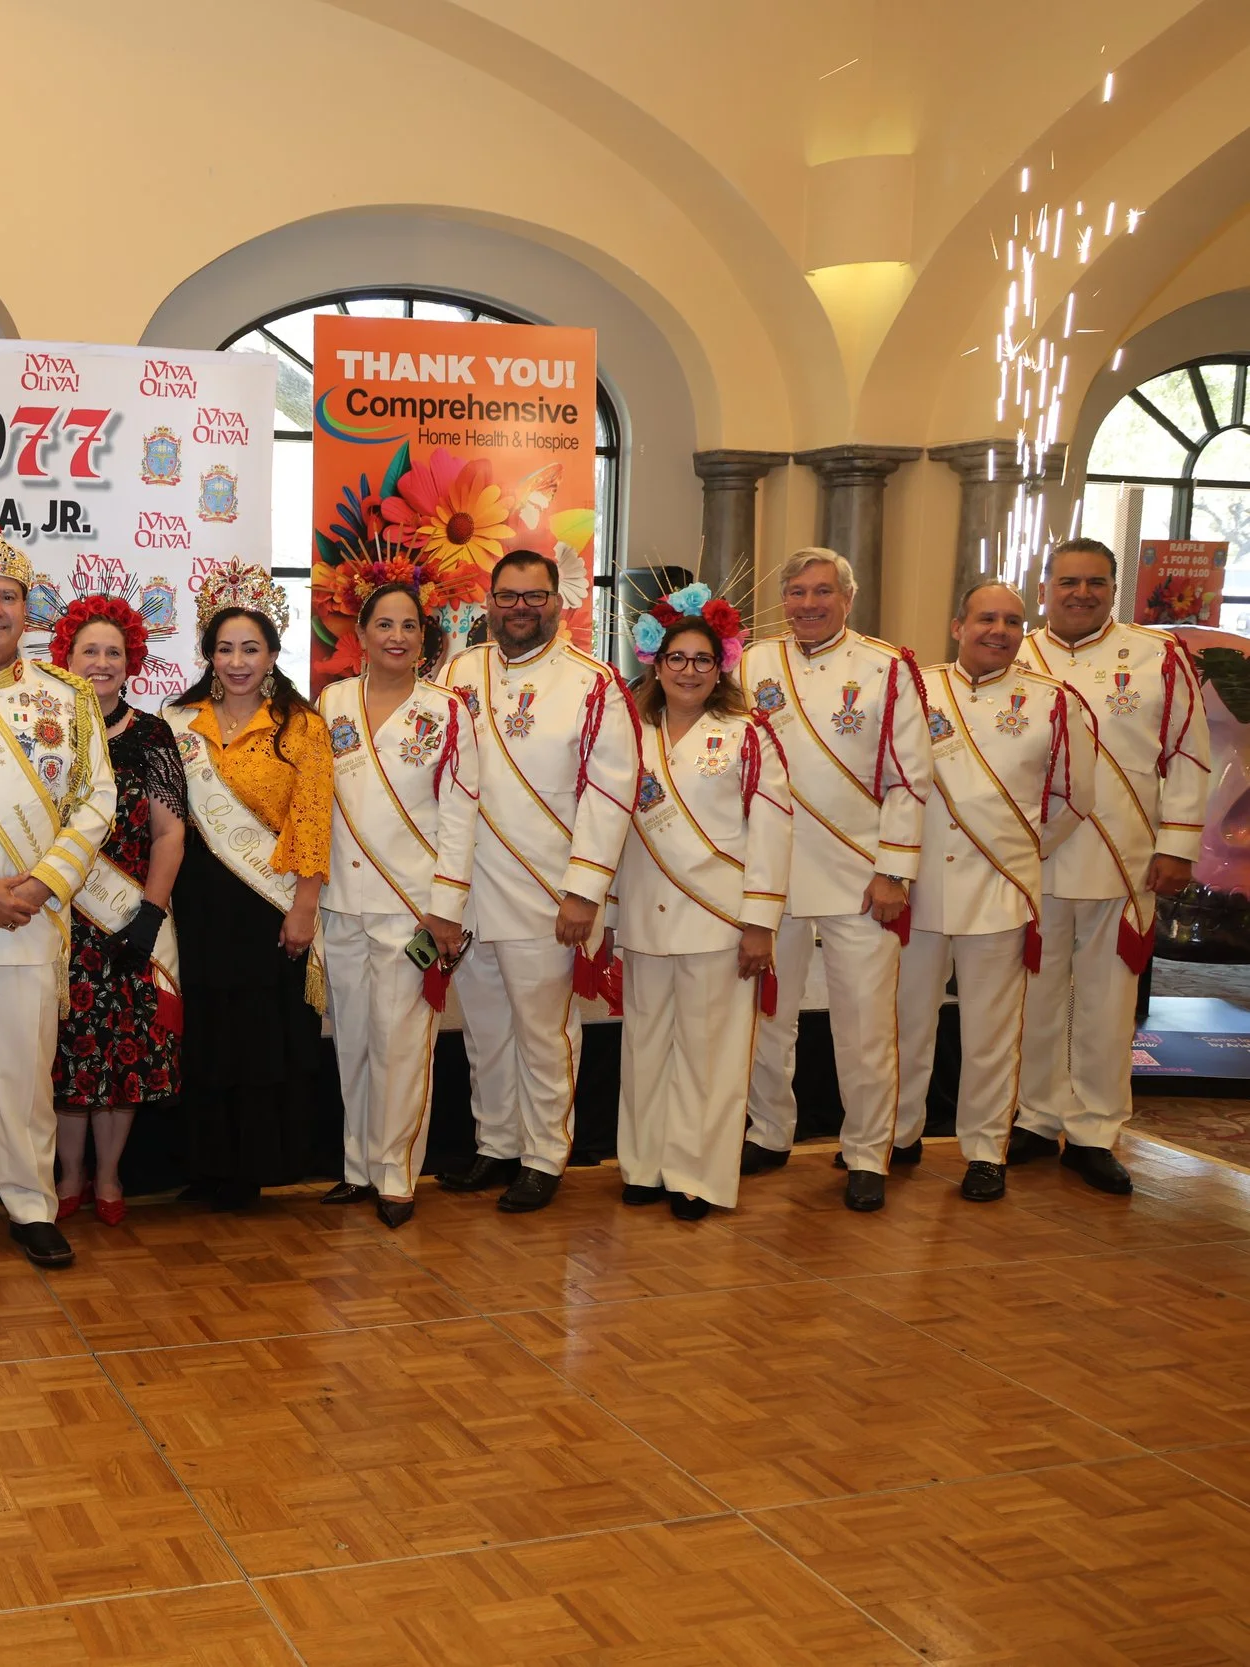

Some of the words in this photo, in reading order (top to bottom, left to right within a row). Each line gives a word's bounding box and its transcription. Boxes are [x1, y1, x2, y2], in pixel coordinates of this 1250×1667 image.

[336, 350, 476, 385] THANK
[485, 356, 576, 389] YOU!
[347, 388, 578, 425] Comprehensive
[418, 428, 461, 446] Home
[465, 429, 508, 448] Health
[512, 432, 523, 448] &
[526, 432, 579, 453] Hospice
[41, 500, 92, 534] JR.
[1170, 543, 1205, 552] RAFFLE
[1171, 555, 1190, 564] FOR
[1167, 568, 1186, 576] FOR
